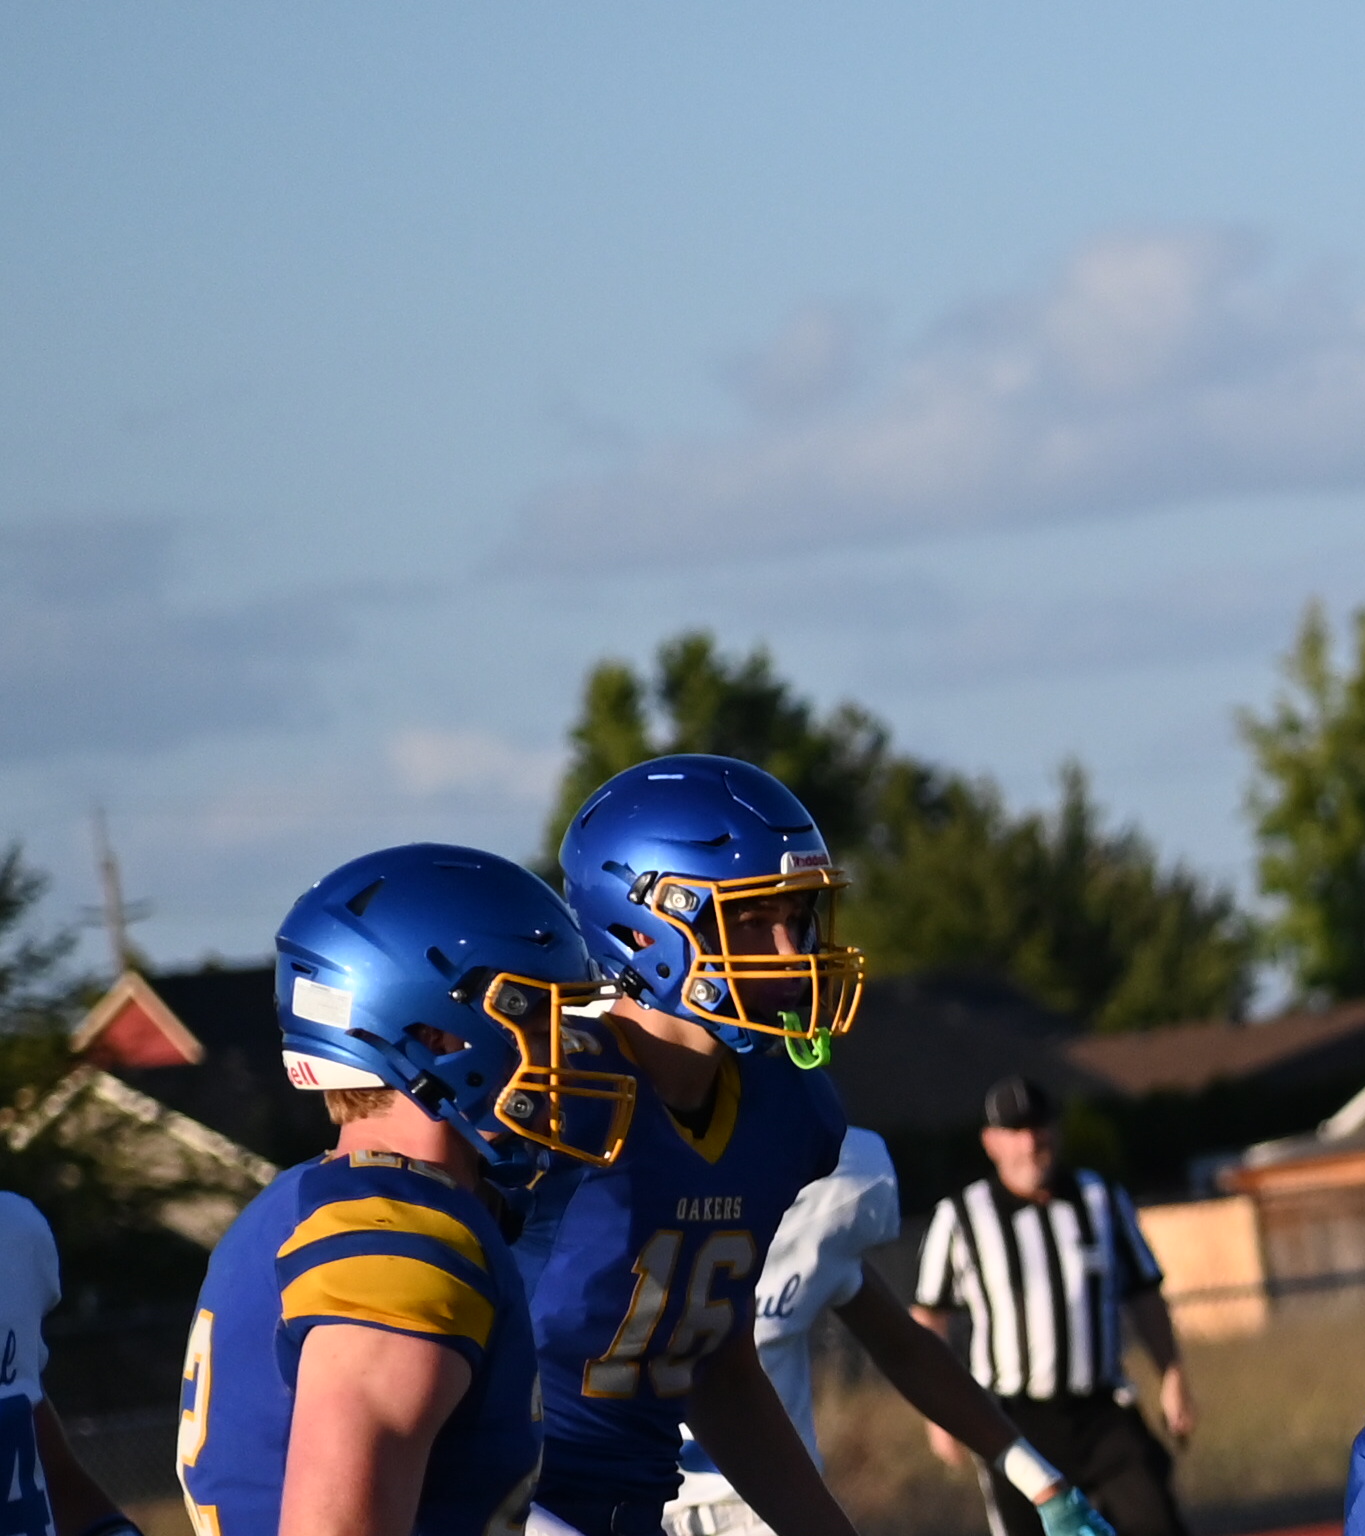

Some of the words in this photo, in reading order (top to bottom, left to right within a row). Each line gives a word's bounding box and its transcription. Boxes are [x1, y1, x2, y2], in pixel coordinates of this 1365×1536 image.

[676, 1196, 742, 1221] OAKERS
[582, 1229, 757, 1397] 16
[755, 1273, 801, 1320] ul
